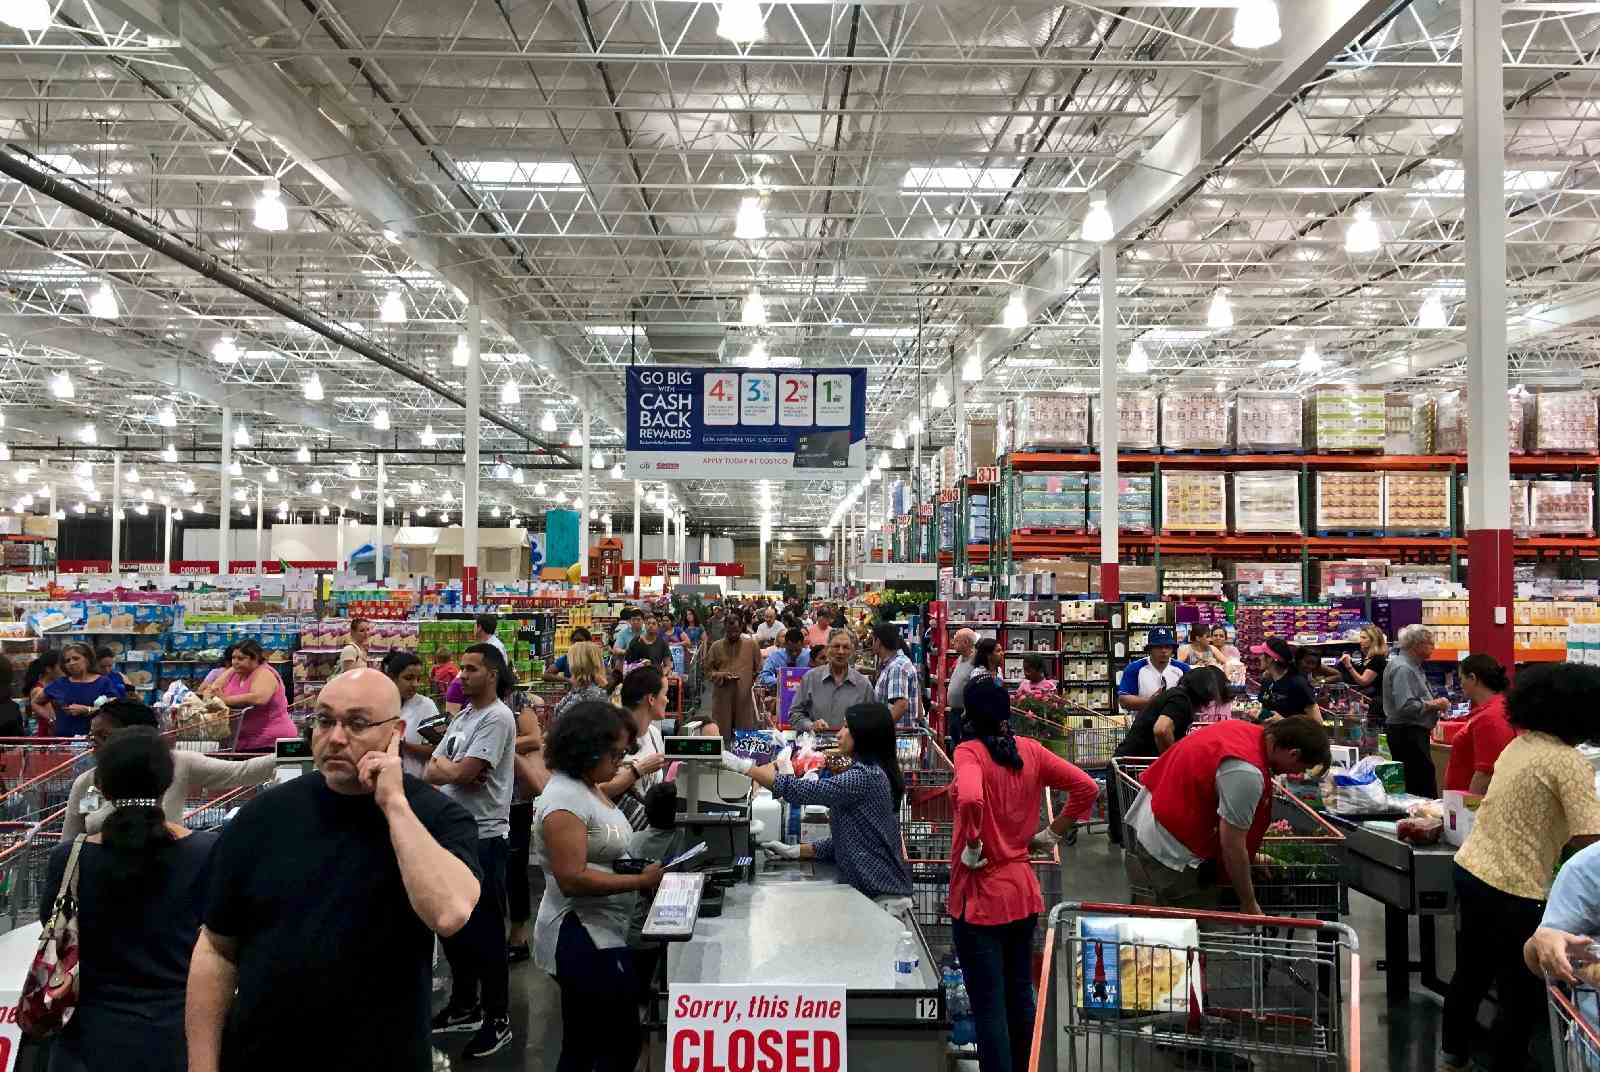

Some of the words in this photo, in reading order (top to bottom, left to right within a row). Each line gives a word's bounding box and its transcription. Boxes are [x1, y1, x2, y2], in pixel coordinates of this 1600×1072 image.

[640, 371, 664, 385] GO
[667, 371, 692, 385] BIG
[640, 393, 692, 410] CASH
[640, 411, 692, 428] BACK
[640, 428, 692, 439] REWARDS
[703, 457, 722, 465] APPLY
[725, 457, 747, 465] TODAY
[760, 457, 788, 465] COSTCO
[978, 467, 997, 482] 301
[941, 488, 959, 501] 303
[674, 994, 742, 1023] Sorry,
[748, 995, 789, 1018] this
[794, 993, 842, 1019] lane
[918, 999, 936, 1018] 12
[672, 1029, 841, 1072] CLOSED
